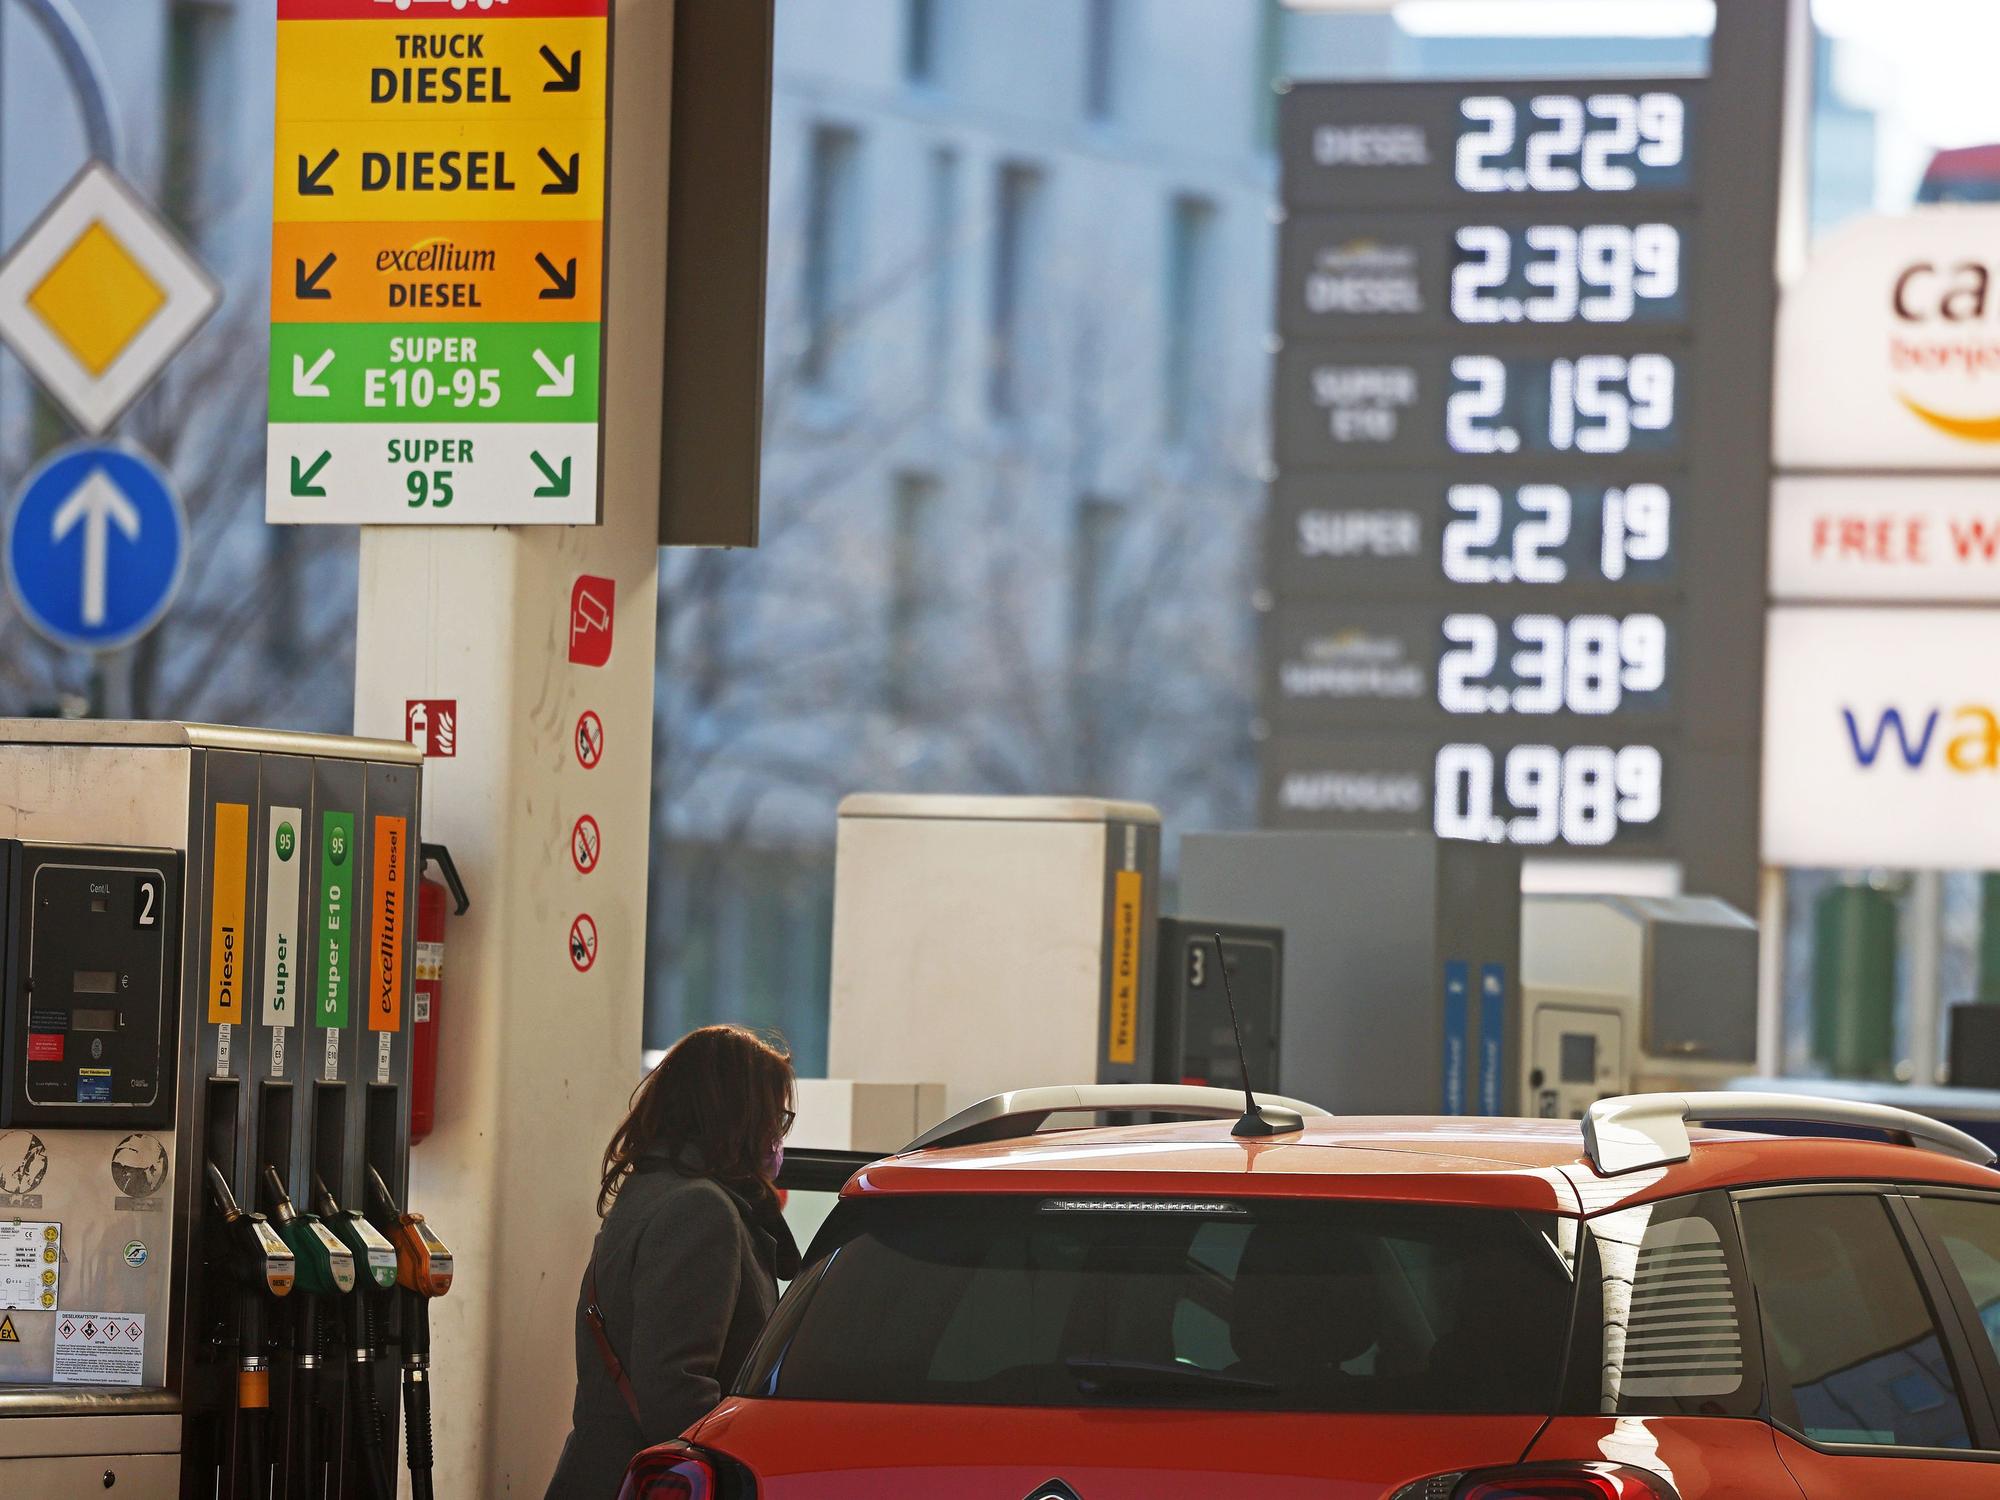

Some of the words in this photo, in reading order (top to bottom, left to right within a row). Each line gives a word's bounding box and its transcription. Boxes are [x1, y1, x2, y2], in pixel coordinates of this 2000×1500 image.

[395, 34, 484, 59] TRUCK
[370, 67, 511, 104] DIESEL
[1455, 92, 1684, 192] 2.229
[361, 151, 515, 191] DIESEL
[376, 243, 496, 272] excellium
[1450, 223, 1680, 323] 2.399
[388, 283, 482, 308] DIESEL
[389, 337, 477, 363] SUPER
[364, 368, 501, 408] E10-95
[387, 439, 474, 464] SUPER
[406, 470, 454, 508] 95
[1300, 510, 1421, 556] SUPER
[1812, 515, 1928, 563] FREE
[1438, 614, 1667, 714] 2.389
[1841, 704, 2000, 773] wa
[1434, 743, 1663, 844] 0.989
[279, 833, 292, 851] 95
[331, 837, 345, 855] 95
[388, 831, 398, 882] Diesel
[139, 882, 155, 925] 2
[328, 885, 341, 930] E10
[219, 926, 234, 1008] Diesel
[273, 933, 289, 1011] Super
[381, 890, 396, 1014] excellium
[1190, 947, 1205, 986] 3
[121, 974, 129, 989] €
[325, 938, 341, 1013] Super
[120, 1012, 126, 1026] L
[1, 1329, 12, 1339] EX
